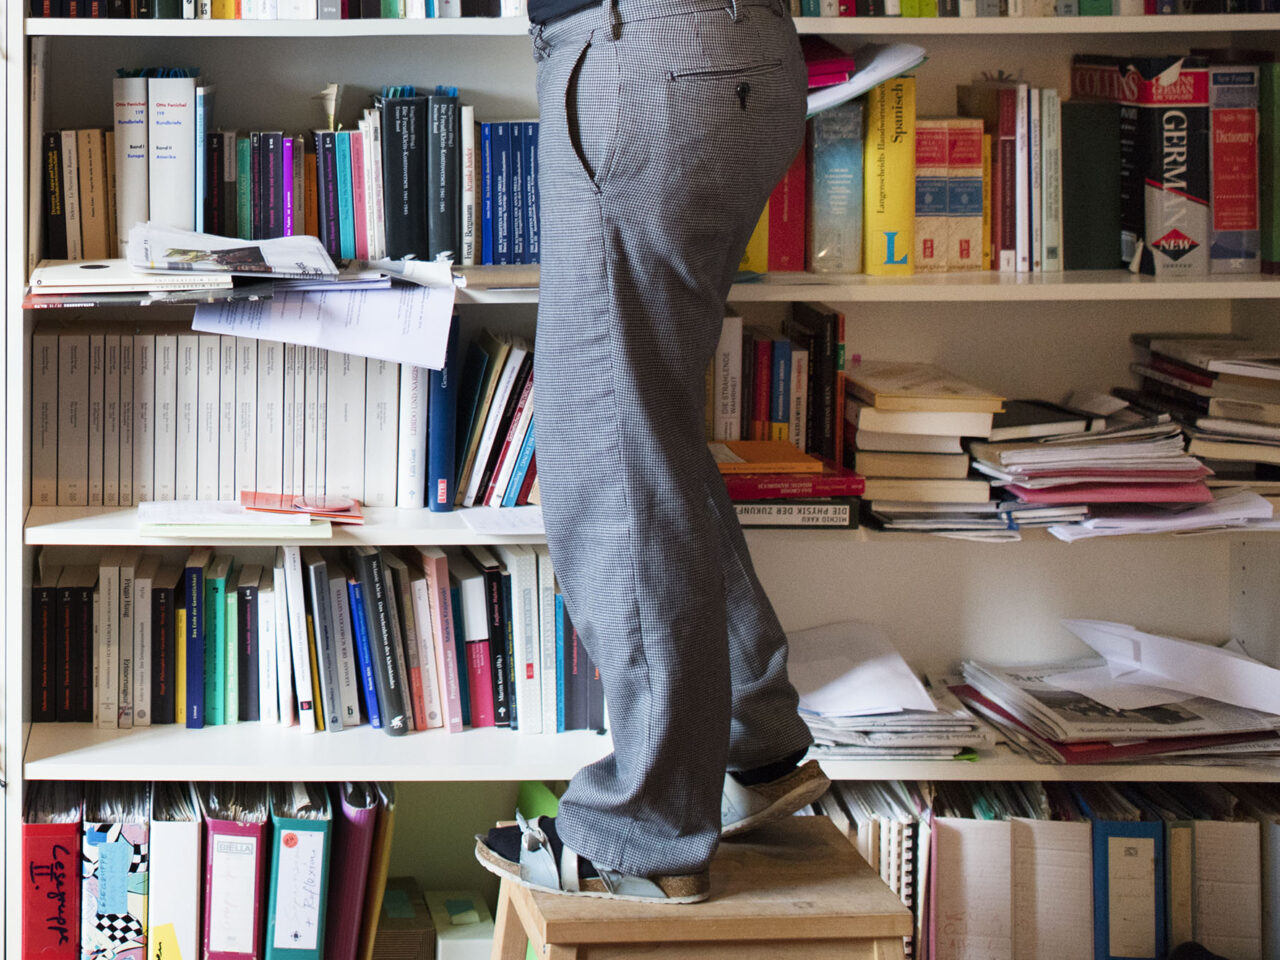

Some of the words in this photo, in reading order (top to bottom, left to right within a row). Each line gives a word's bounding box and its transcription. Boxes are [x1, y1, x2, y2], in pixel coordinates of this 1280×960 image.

[891, 81, 904, 144] Spanisch
[1215, 129, 1256, 146] Dictionary
[876, 151, 885, 214] Langenscheidts
[1163, 112, 1187, 228] GERMAN
[464, 205, 472, 237] Bergmann
[464, 242, 472, 259] Freud
[883, 232, 907, 265] L
[1160, 239, 1192, 252] NEW
[218, 843, 252, 852] BIELLA
